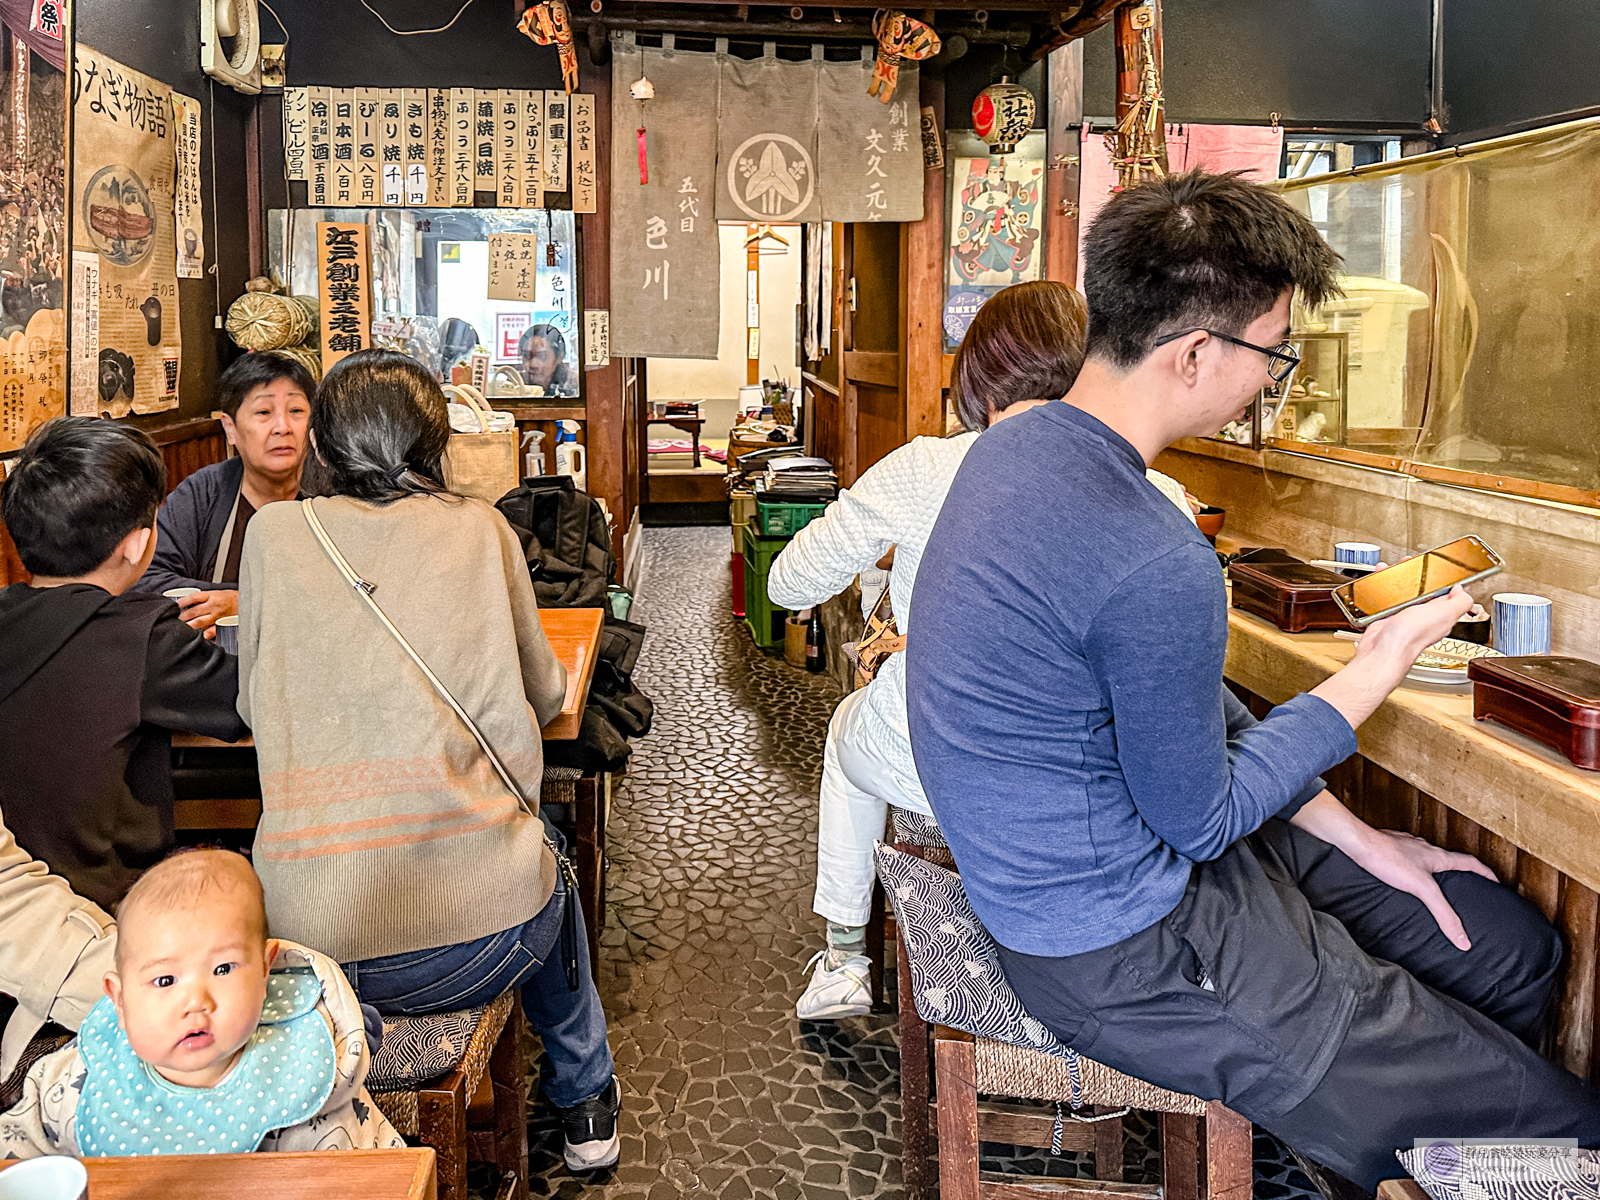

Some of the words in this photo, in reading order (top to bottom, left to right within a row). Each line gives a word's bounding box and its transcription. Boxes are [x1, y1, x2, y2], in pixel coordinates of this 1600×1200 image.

[40, 0, 59, 35] 祭
[335, 102, 353, 160] 日本酒
[359, 101, 379, 158] びーる
[407, 102, 425, 161] きも焼
[456, 101, 469, 148] ふつう
[503, 102, 517, 148] ふつう
[526, 101, 542, 151] たっぷり
[548, 102, 565, 140] 鰻重
[889, 100, 909, 152] 創業
[287, 119, 306, 179] ビール四百円
[335, 162, 353, 202] 八百円
[358, 162, 377, 202] 八百円
[385, 166, 401, 204] 千円
[409, 165, 425, 204] 千円
[454, 152, 471, 204] 三千八百円
[502, 152, 518, 204] 三千八百円
[524, 153, 540, 207] 五千二百円
[677, 175, 699, 234] 五代目
[503, 237, 519, 270] ご飯は
[641, 214, 670, 301] 色川
[325, 226, 363, 353] 江戸創業之老舗
[551, 274, 565, 312] 色川
